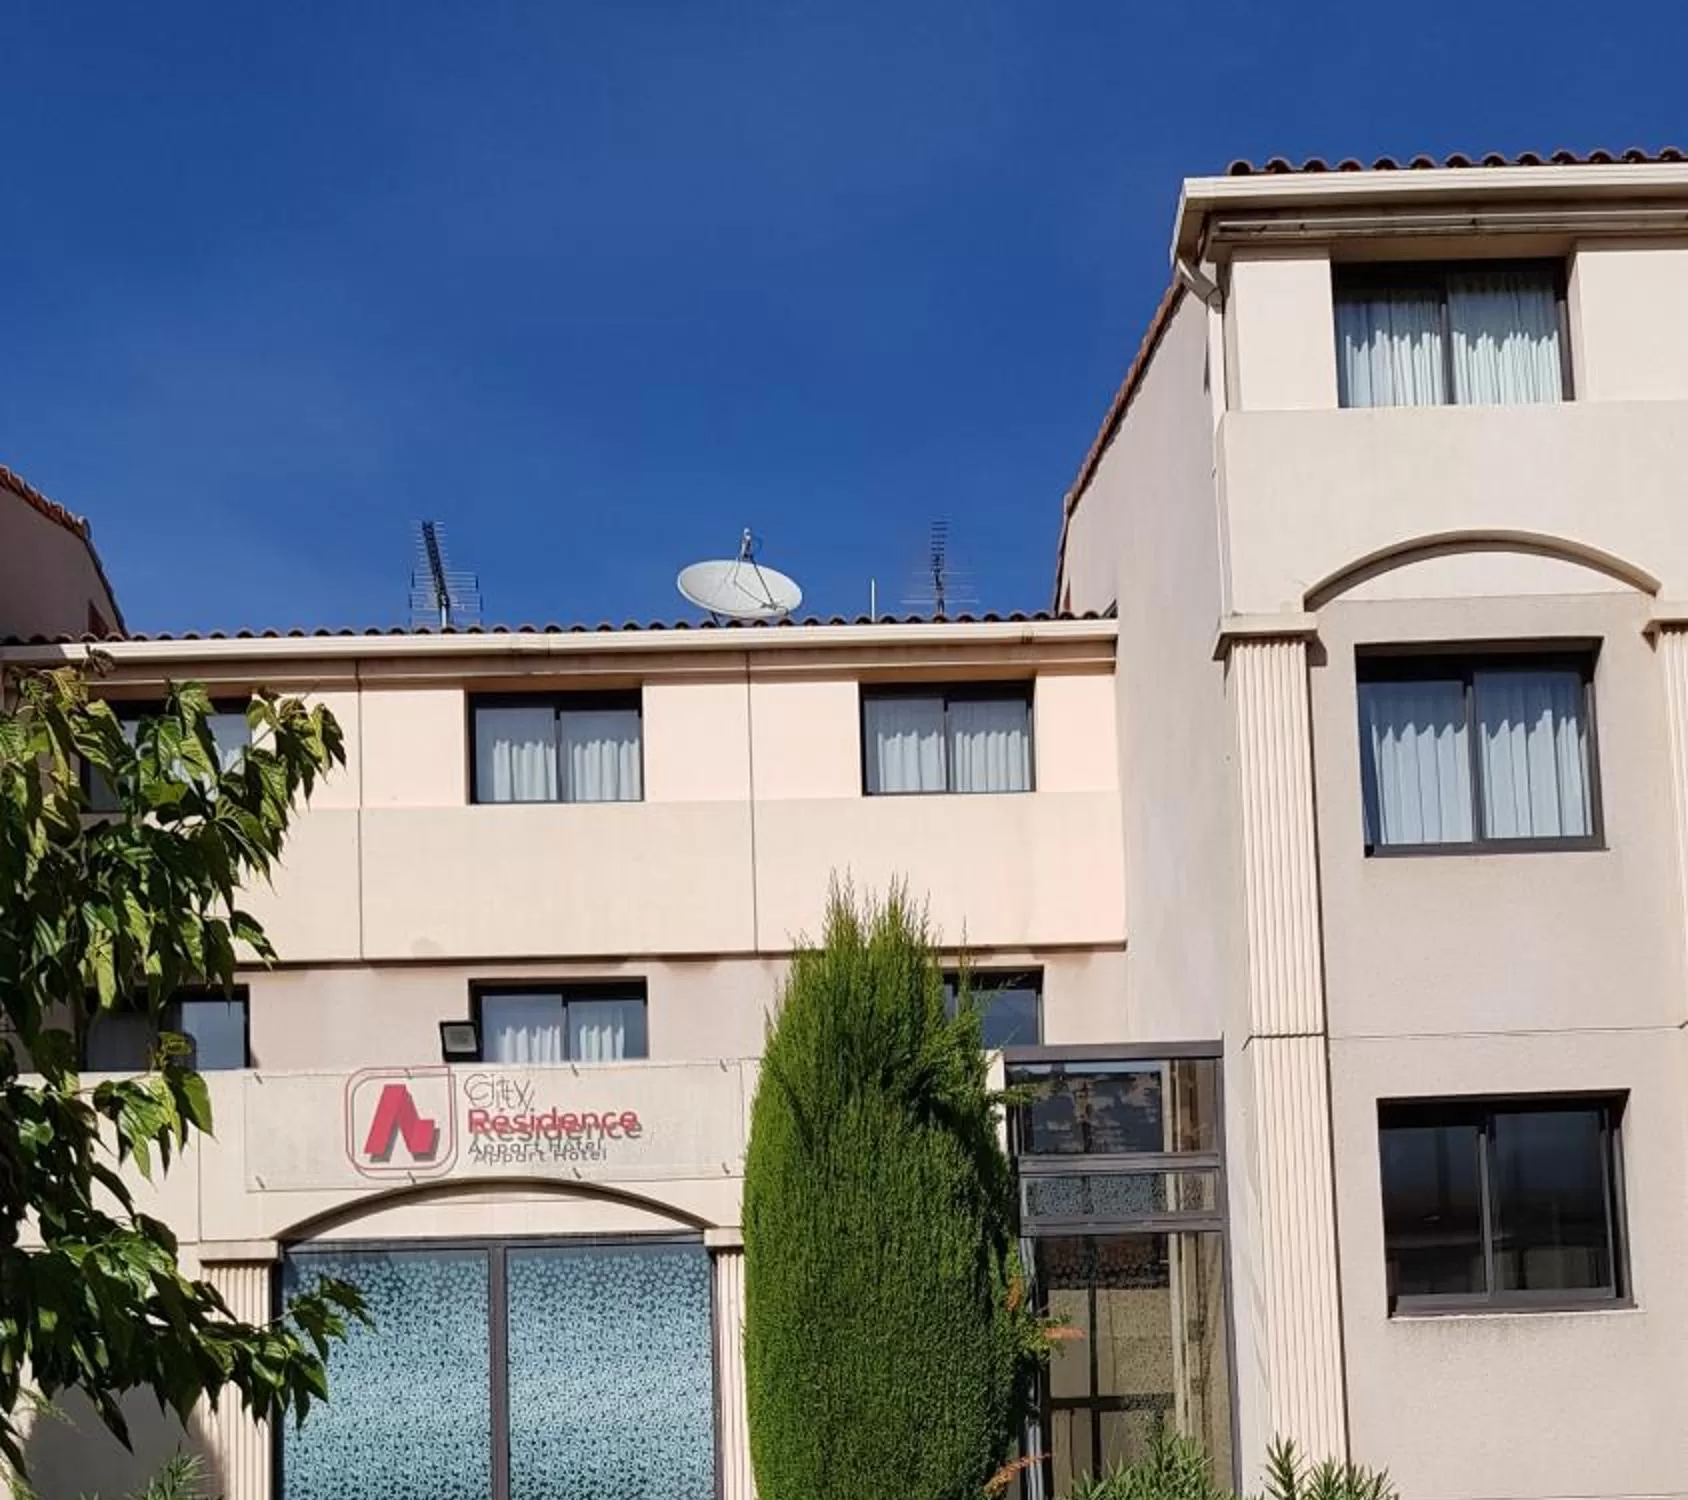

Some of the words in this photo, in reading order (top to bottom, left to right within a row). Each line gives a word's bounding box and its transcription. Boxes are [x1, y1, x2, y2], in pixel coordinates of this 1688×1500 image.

[464, 1073, 532, 1108] City
[467, 1107, 638, 1135] Résidence
[468, 1140, 541, 1158] Appart
